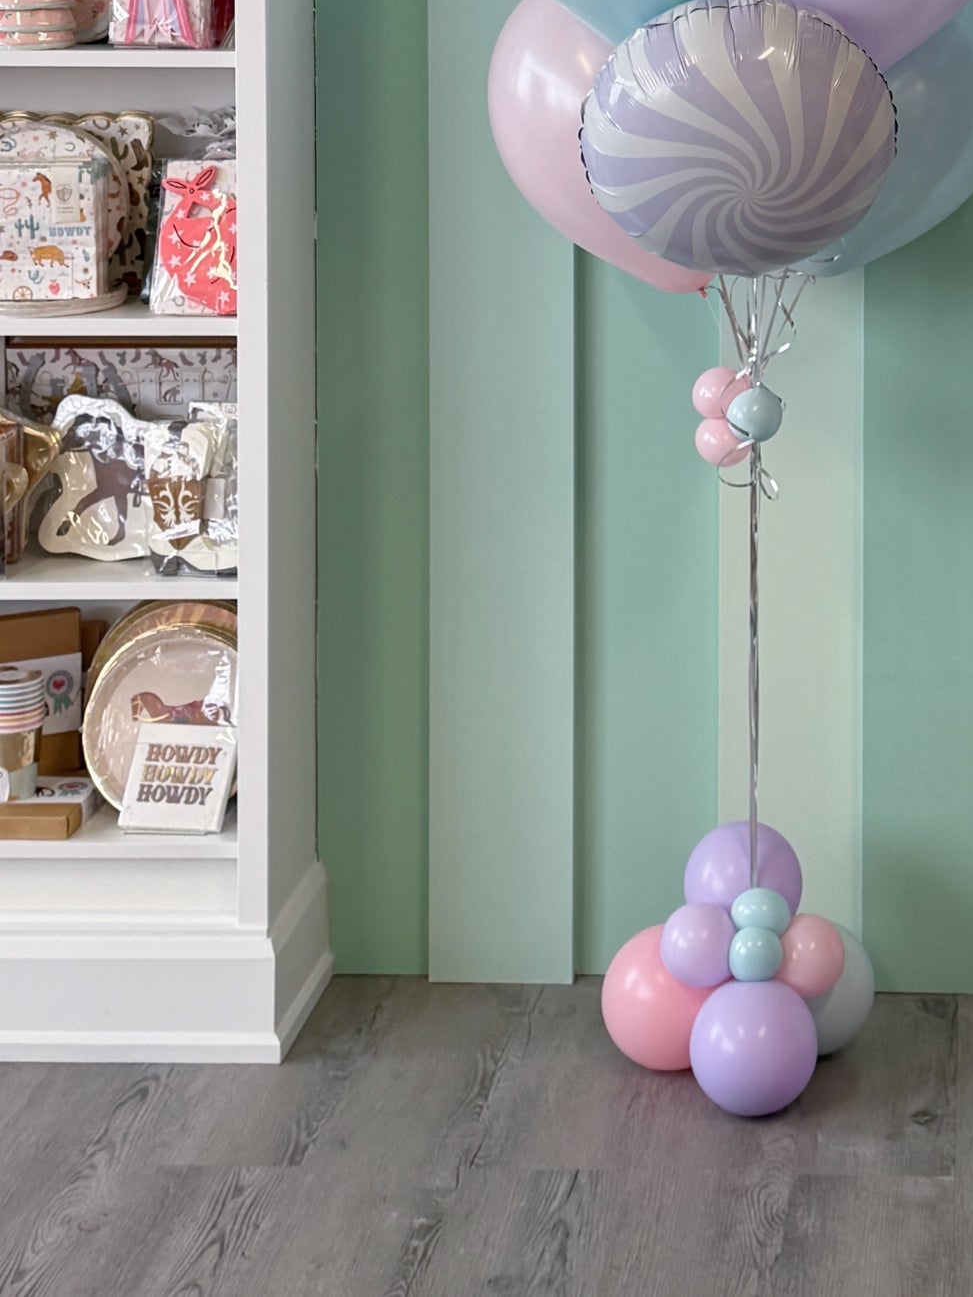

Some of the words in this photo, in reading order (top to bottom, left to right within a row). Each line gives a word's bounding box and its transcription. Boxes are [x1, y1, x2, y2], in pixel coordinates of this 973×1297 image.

[49, 226, 91, 237] HOWDY
[145, 743, 223, 765] HOWDY
[141, 764, 218, 785] HOWDY
[136, 783, 214, 806] HOWDY
